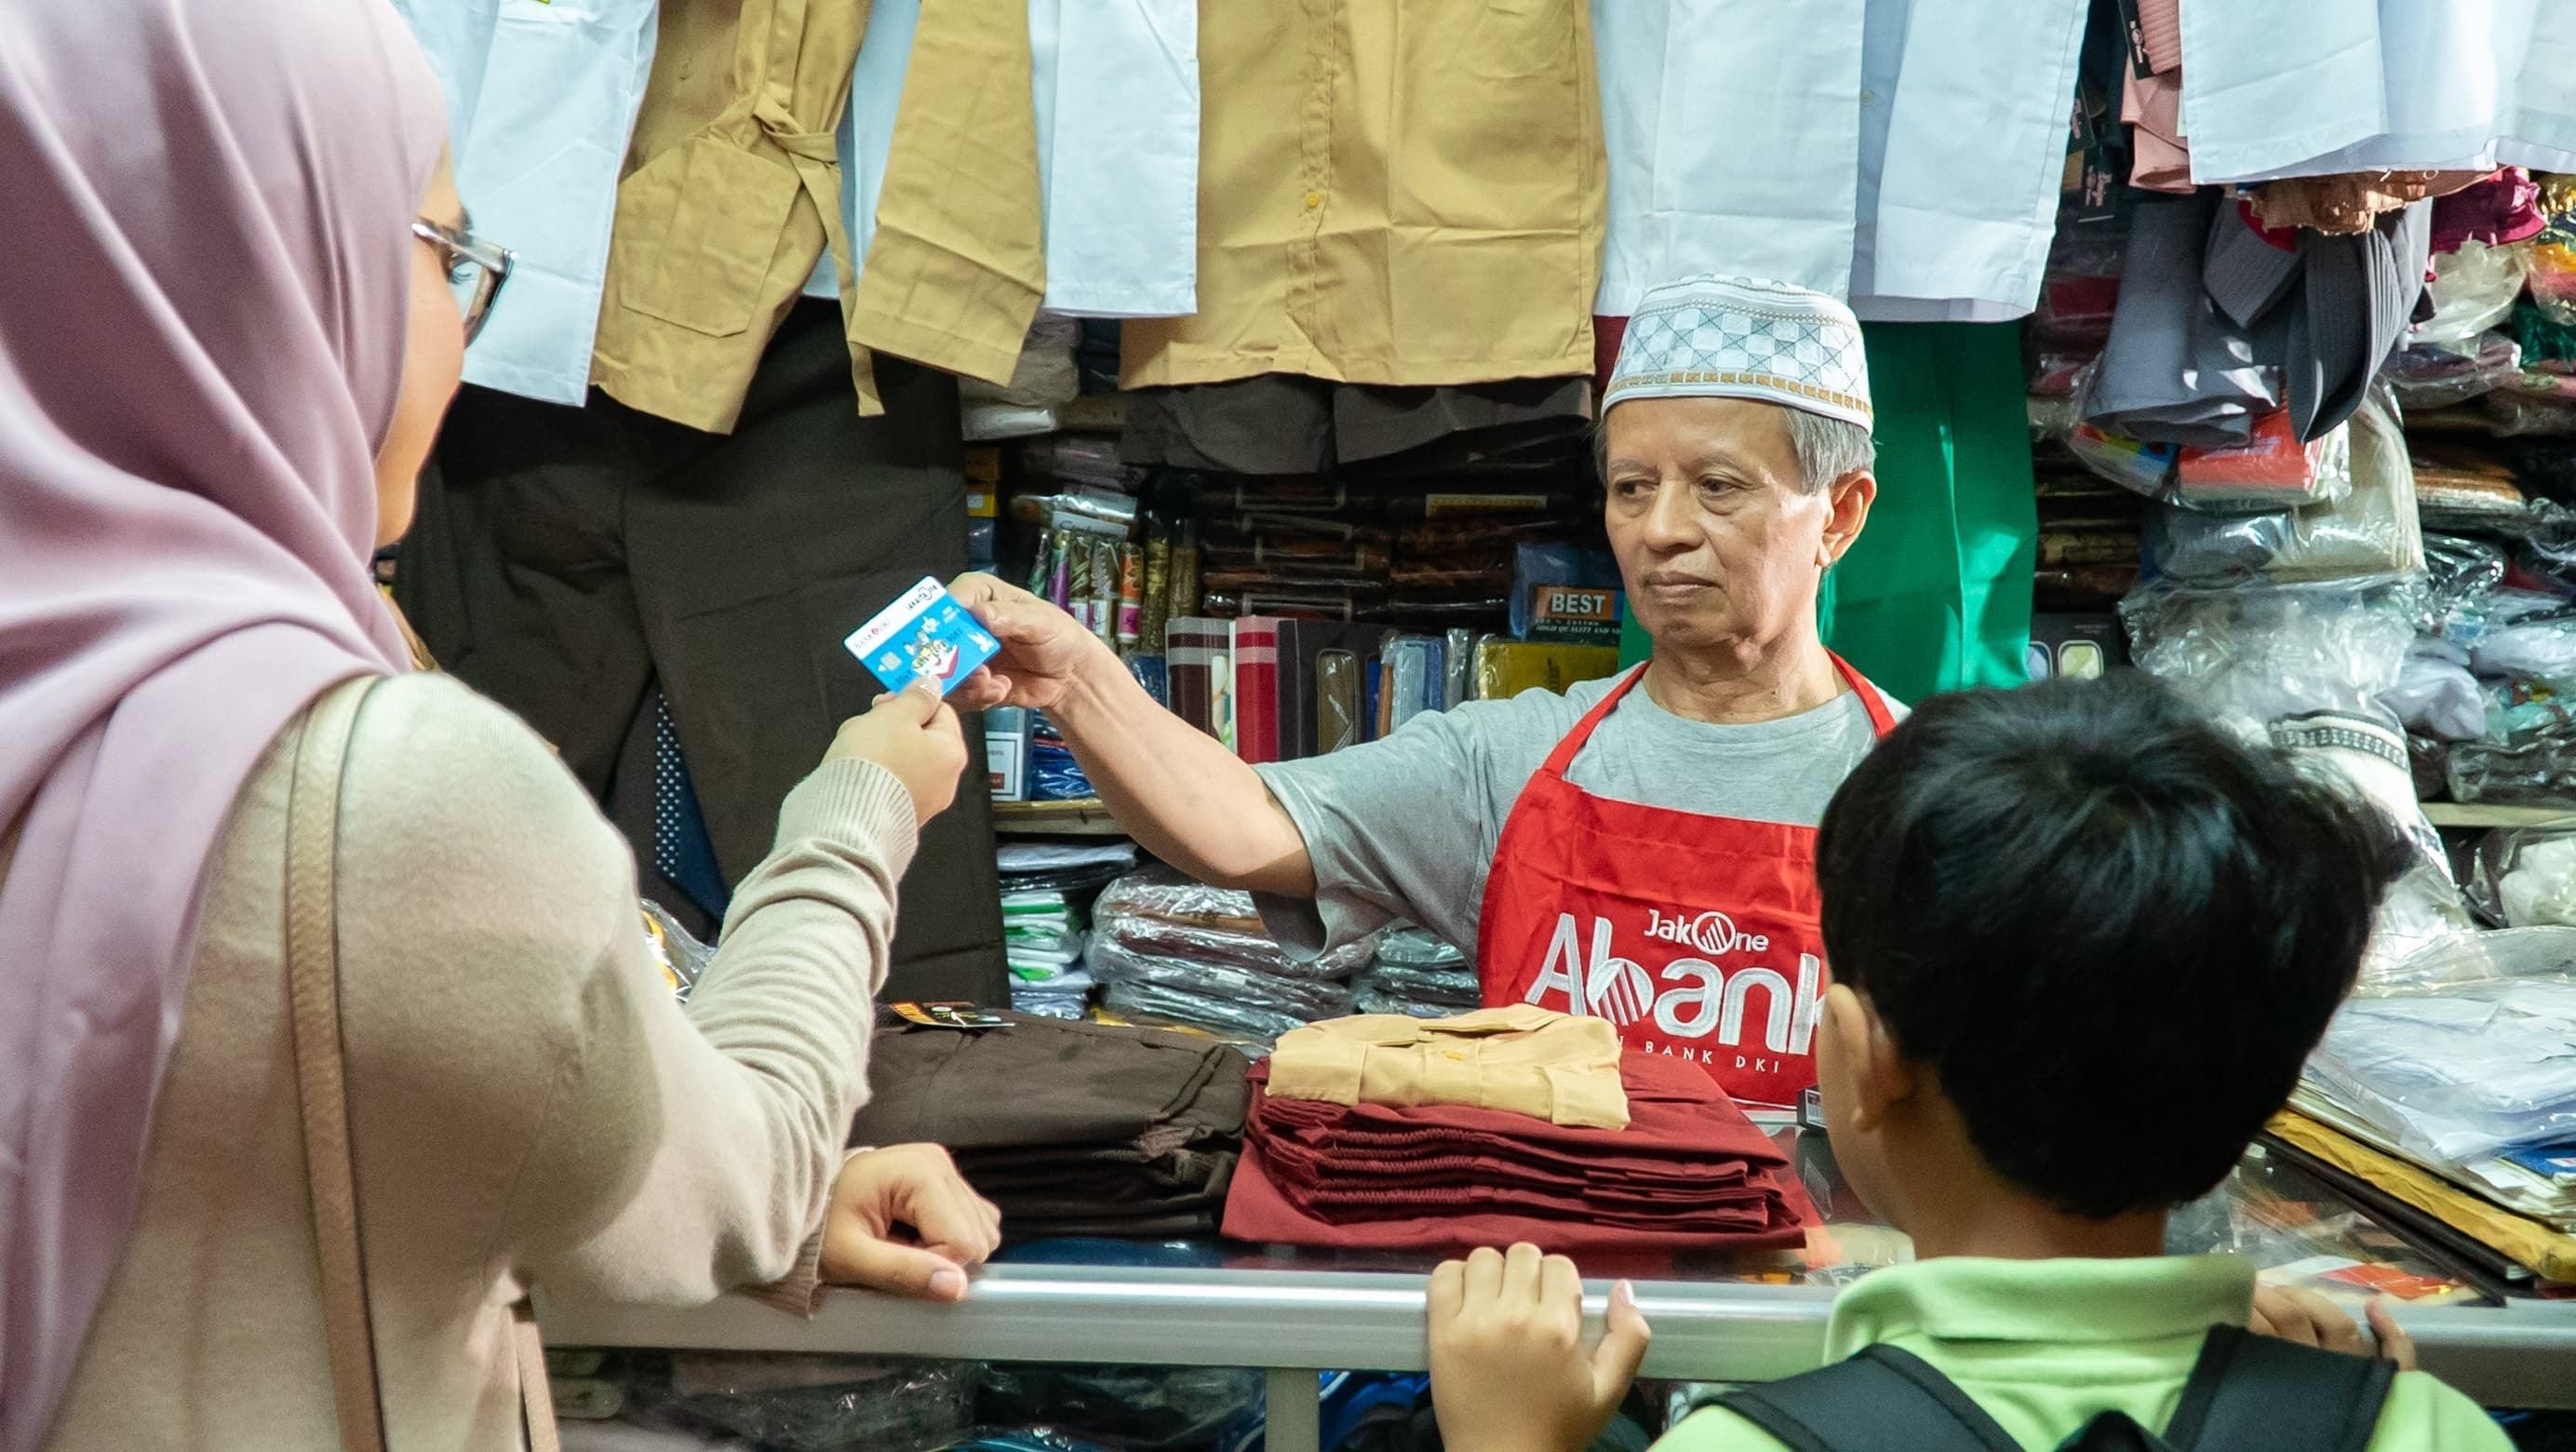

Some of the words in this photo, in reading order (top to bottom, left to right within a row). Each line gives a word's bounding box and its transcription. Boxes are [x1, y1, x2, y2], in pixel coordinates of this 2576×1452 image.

[1551, 593, 1606, 614] BEST
[1644, 908, 1769, 955] JakOne
[1644, 1041, 1713, 1065] BANK
[1736, 1056, 1780, 1074] DKI
